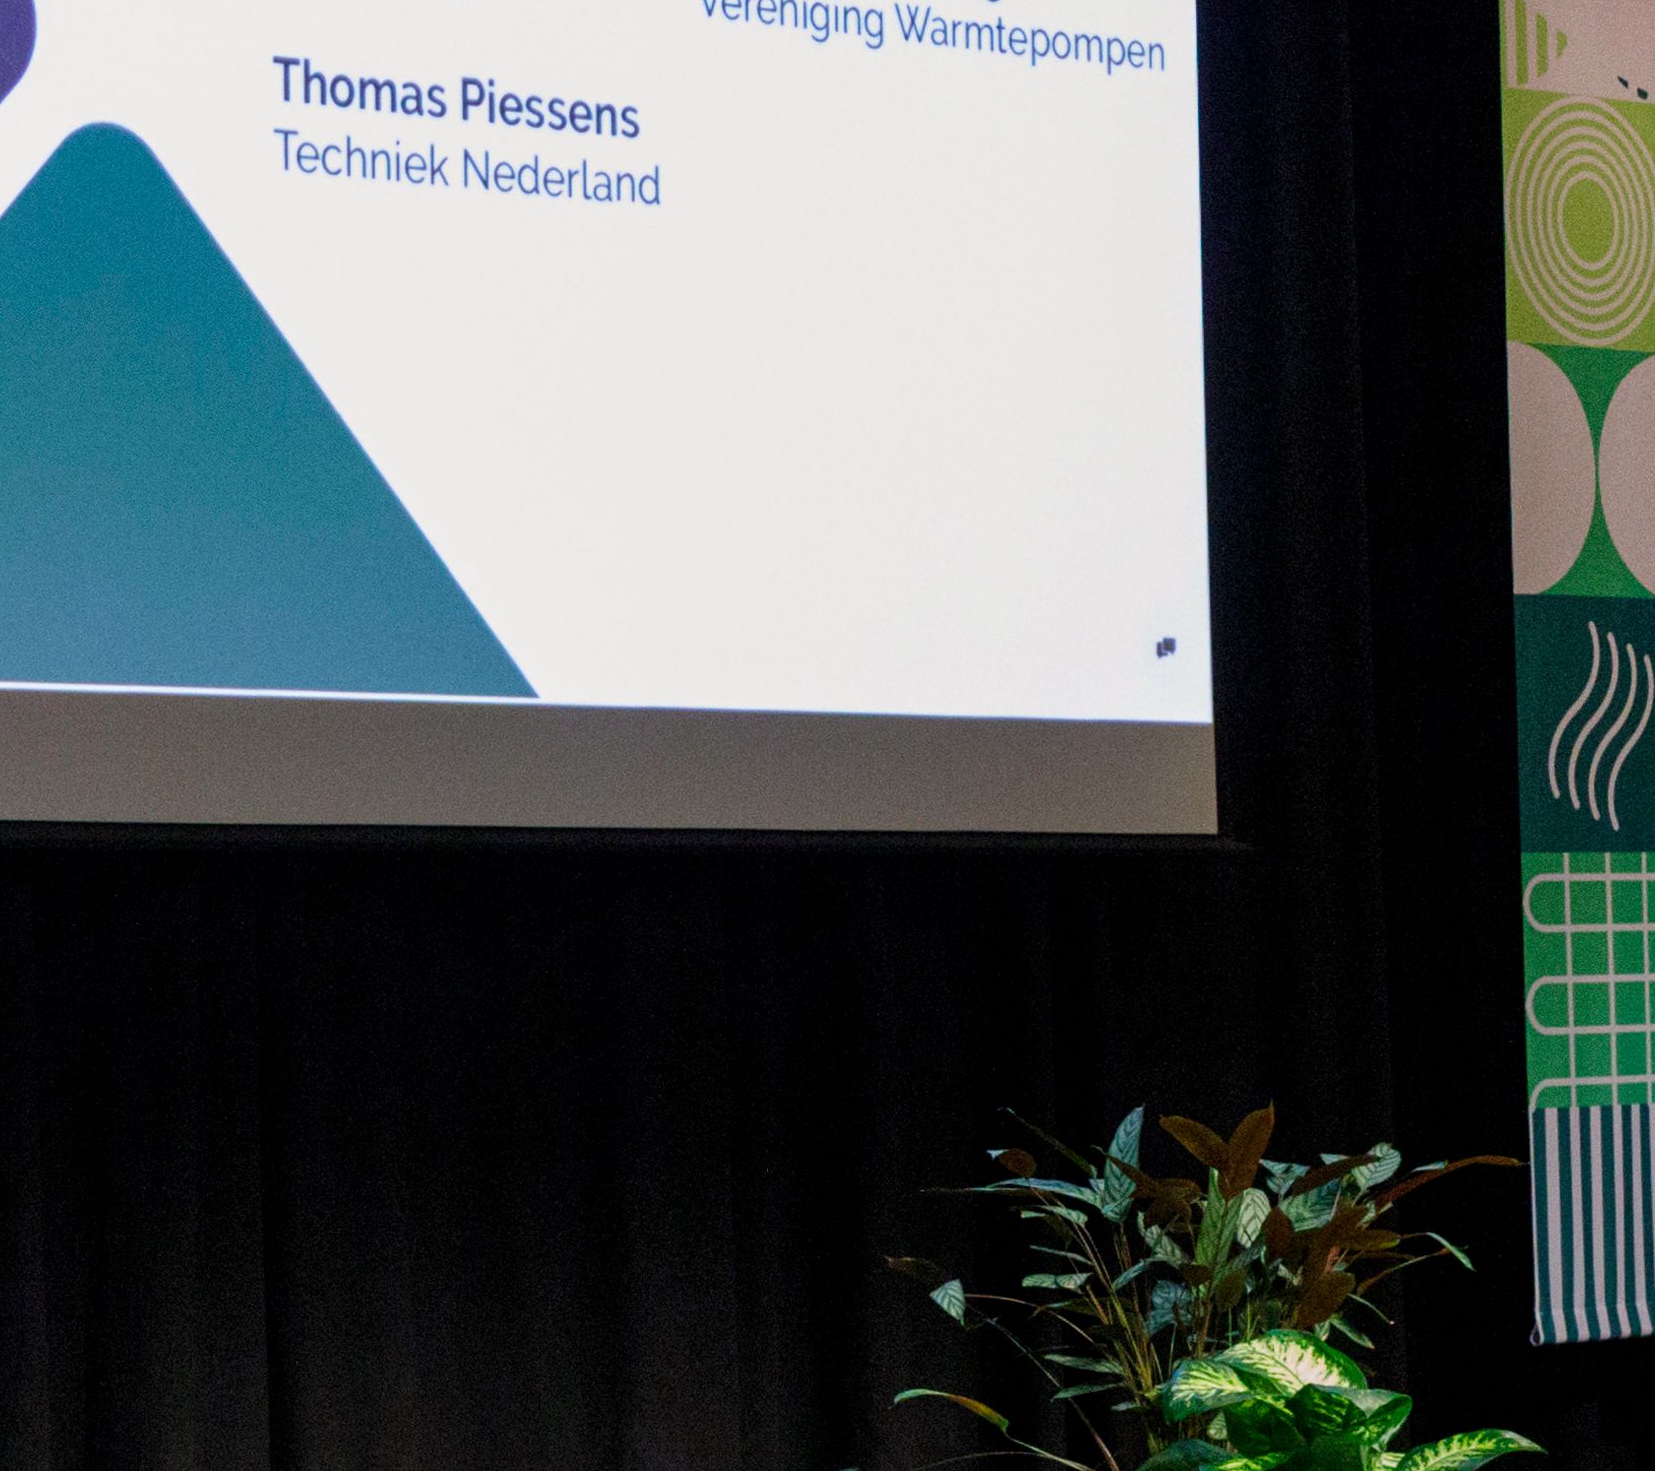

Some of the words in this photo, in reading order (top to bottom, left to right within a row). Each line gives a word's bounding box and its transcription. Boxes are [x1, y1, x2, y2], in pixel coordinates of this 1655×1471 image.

[894, 2, 1167, 77] Warmtepompen
[272, 55, 448, 121] Thomas
[460, 75, 641, 140] Piessens
[273, 129, 449, 190] Techniek
[462, 150, 663, 207] Nederland
